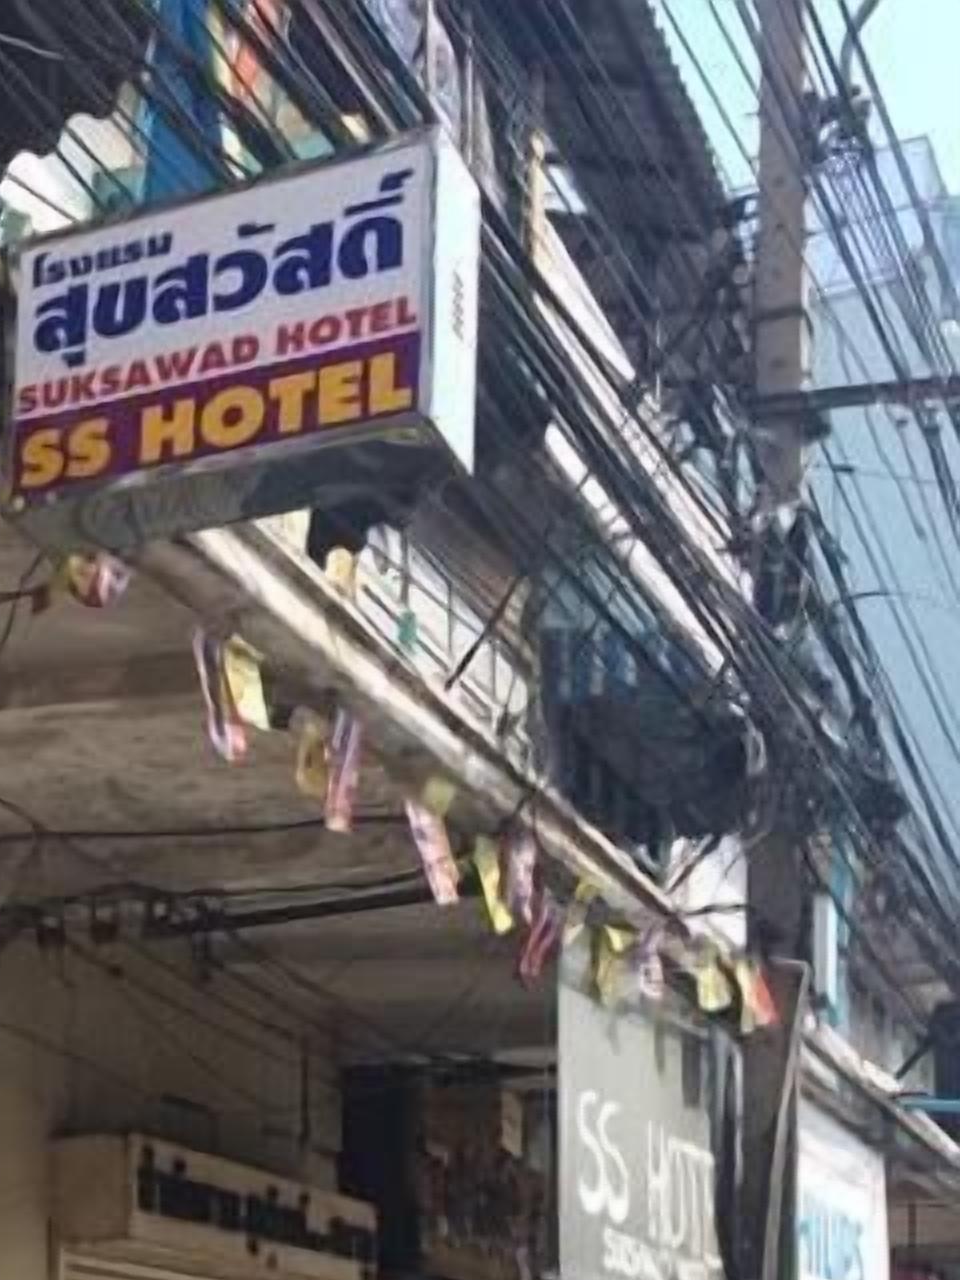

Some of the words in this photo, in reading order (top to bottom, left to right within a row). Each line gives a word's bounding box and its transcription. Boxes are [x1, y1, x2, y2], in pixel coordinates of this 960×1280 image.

[33, 231, 174, 289] โรงแรม
[17, 334, 261, 414] SUKSAWAD
[276, 296, 418, 358] HOTEL
[20, 417, 112, 489] SS
[140, 351, 415, 463] HOTEL
[578, 1087, 630, 1225] SS
